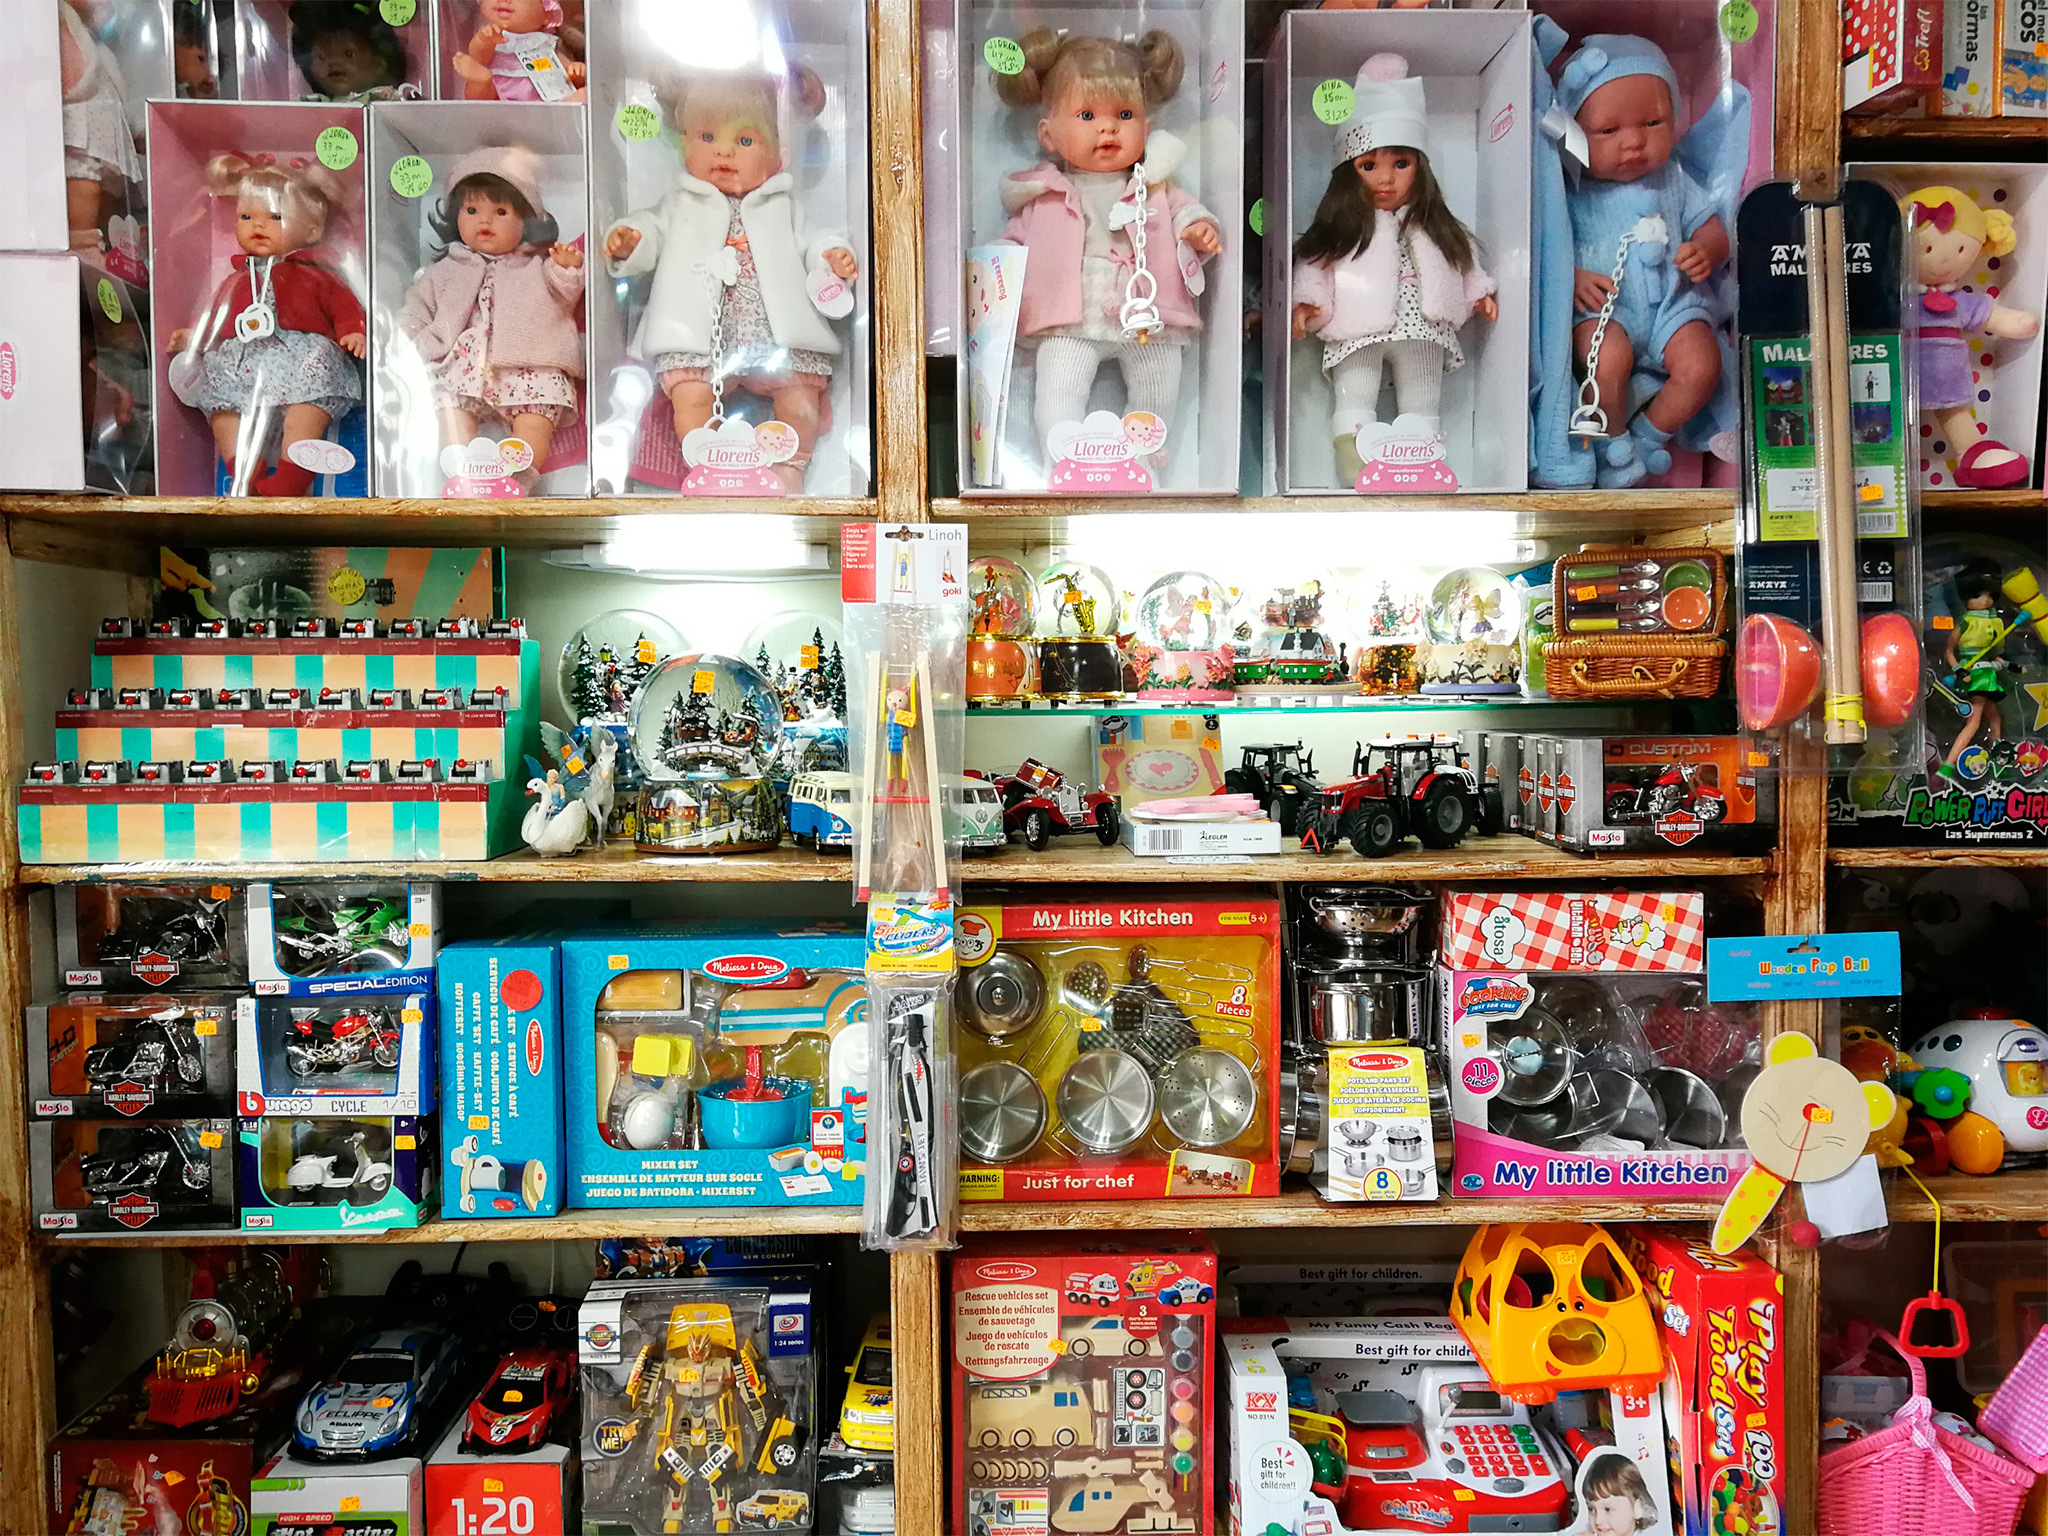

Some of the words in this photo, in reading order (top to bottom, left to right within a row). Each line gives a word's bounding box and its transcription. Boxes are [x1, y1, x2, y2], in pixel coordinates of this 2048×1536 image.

[1915, 8, 1933, 48] Trefl
[1966, 0, 1979, 62] ormas
[2037, 14, 2046, 43] meu
[1321, 81, 1341, 92] NINA
[1770, 261, 1873, 277] MALRES
[1762, 342, 1889, 363] MALRES
[1, 350, 14, 393] Llorens
[707, 449, 760, 463] Llorens
[1074, 442, 1129, 456] Llorens
[1382, 444, 1435, 458] Llorens
[462, 463, 505, 474] Llorens
[929, 529, 962, 541] Linoh
[1749, 581, 1787, 589] AMAYA
[942, 587, 962, 598] goki
[1629, 742, 1711, 756] CUSTOM
[1659, 823, 1700, 833] HARLEY-DAVIDSON
[1592, 832, 1621, 845] Maisto
[1945, 830, 1962, 840] Las
[1964, 829, 2024, 843] Supernenas
[1032, 910, 1062, 931] My
[1069, 909, 1113, 927] little
[1120, 908, 1194, 927] Kitchen
[874, 922, 924, 938] Speed
[135, 964, 177, 973] HARLEY-DAVIDSON
[712, 961, 748, 973] Melissa
[757, 961, 781, 975] Doug
[1759, 962, 1806, 976] Wooden
[1810, 957, 1837, 976] Pop
[1843, 956, 1870, 972] Ball
[69, 973, 99, 985] Maisto
[489, 957, 498, 1004] SERVICIO
[258, 983, 286, 994] Maisto
[1231, 985, 1247, 1005] 8
[894, 994, 925, 1011] JAWS
[1461, 986, 1530, 1008] COOKING
[455, 982, 464, 1036] KOFFIESET
[490, 1005, 499, 1019] DE
[1216, 1002, 1251, 1017] Pieces
[490, 1019, 501, 1045] CAFÉ
[455, 1042, 466, 1093] КОФЕЙНЫЙ
[508, 1042, 517, 1084] SERVICE
[1352, 1057, 1381, 1067] Melissa
[1387, 1058, 1406, 1069] Doug
[1473, 1063, 1489, 1077] 11
[473, 1051, 483, 1112] KAFFEE-SET
[491, 1051, 500, 1105] CONJUNTO
[1347, 1077, 1364, 1085] POTS
[1364, 1077, 1379, 1085] AND
[1379, 1077, 1398, 1085] PANS
[107, 1093, 151, 1102] HARLEY-DAVIDSON
[1332, 1097, 1354, 1105] JUEGO
[1401, 1096, 1428, 1104] COCINA
[39, 1103, 69, 1115] Maisto
[331, 1100, 367, 1113] CYCLE
[382, 1099, 417, 1111] 1/18
[456, 1093, 465, 1122] НАБОР
[491, 1106, 500, 1120] DE
[508, 1094, 520, 1118] CAFÉ
[1353, 1106, 1407, 1114] TOPFSORTIMENT
[491, 1121, 502, 1146] CAFÉ
[641, 1160, 677, 1170] MIXER
[677, 1160, 699, 1170] SET
[581, 1174, 638, 1184] ENSEMBLE
[638, 1174, 654, 1184] DE
[654, 1174, 705, 1184] BATTEUR
[705, 1173, 728, 1183] SUR
[728, 1173, 764, 1183] SOCLE
[959, 1174, 1001, 1184] WARNING:
[1022, 1177, 1059, 1191] Just
[1063, 1175, 1091, 1189] for
[1095, 1173, 1135, 1188] chef
[1376, 1171, 1389, 1190] 8
[1494, 1161, 1538, 1190] My
[1548, 1160, 1611, 1184] little
[1621, 1160, 1728, 1184] Kitchen
[586, 1188, 622, 1198] JUEGO
[622, 1188, 639, 1198] DE
[639, 1187, 695, 1198] BATIDORA
[701, 1186, 757, 1197] MIXERSET
[112, 1205, 155, 1215] HARLEY-DAVIDSON
[340, 1204, 405, 1228] Vespa
[43, 1217, 74, 1228] Maisto
[248, 1217, 271, 1226] Maisto
[982, 1266, 1009, 1277] Melissa
[1014, 1266, 1031, 1278] Doug
[1300, 1268, 1327, 1280] Best
[1328, 1268, 1348, 1282] gift
[1351, 1267, 1370, 1280] for
[1371, 1267, 1423, 1280] children.
[965, 1291, 995, 1301] Rescue
[994, 1291, 1027, 1301] vehicles
[1027, 1292, 1049, 1301] set
[958, 1306, 1001, 1316] Ensemble
[1001, 1306, 1013, 1316] de
[1014, 1305, 1056, 1315] véhicules
[1139, 1304, 1148, 1317] 3
[978, 1317, 990, 1326] de
[990, 1317, 1036, 1328] sauvetage
[1308, 1321, 1330, 1331] My
[1334, 1321, 1379, 1331] Funny
[1383, 1321, 1420, 1330] Cash
[1663, 1303, 1692, 1338] Set
[774, 1339, 786, 1347] 1:24
[787, 1339, 805, 1347] series
[965, 1331, 993, 1343] Juego
[994, 1330, 1006, 1340] de
[1006, 1329, 1049, 1340] vehículos
[984, 1341, 996, 1351] de
[996, 1341, 1030, 1351] rescate
[1355, 1343, 1383, 1355] Best
[1387, 1343, 1409, 1358] gift
[1413, 1343, 1433, 1356] for
[965, 1355, 1049, 1366] Rettungsfahrzeuge
[1707, 1305, 1738, 1409] Food
[1735, 1303, 1777, 1408] Play
[1625, 1395, 1648, 1411] 3+
[325, 1409, 384, 1421] ECLIPPE
[600, 1425, 623, 1438] TRY
[1714, 1405, 1737, 1457] Set
[601, 1437, 624, 1450] ME!
[1261, 1457, 1283, 1470] Best
[1260, 1470, 1274, 1481] gift
[1275, 1470, 1287, 1480] for
[451, 1495, 535, 1536] 1:20
[1409, 1499, 1454, 1522] Register
[279, 1513, 301, 1523] HIGH
[304, 1513, 333, 1522] SPEED
